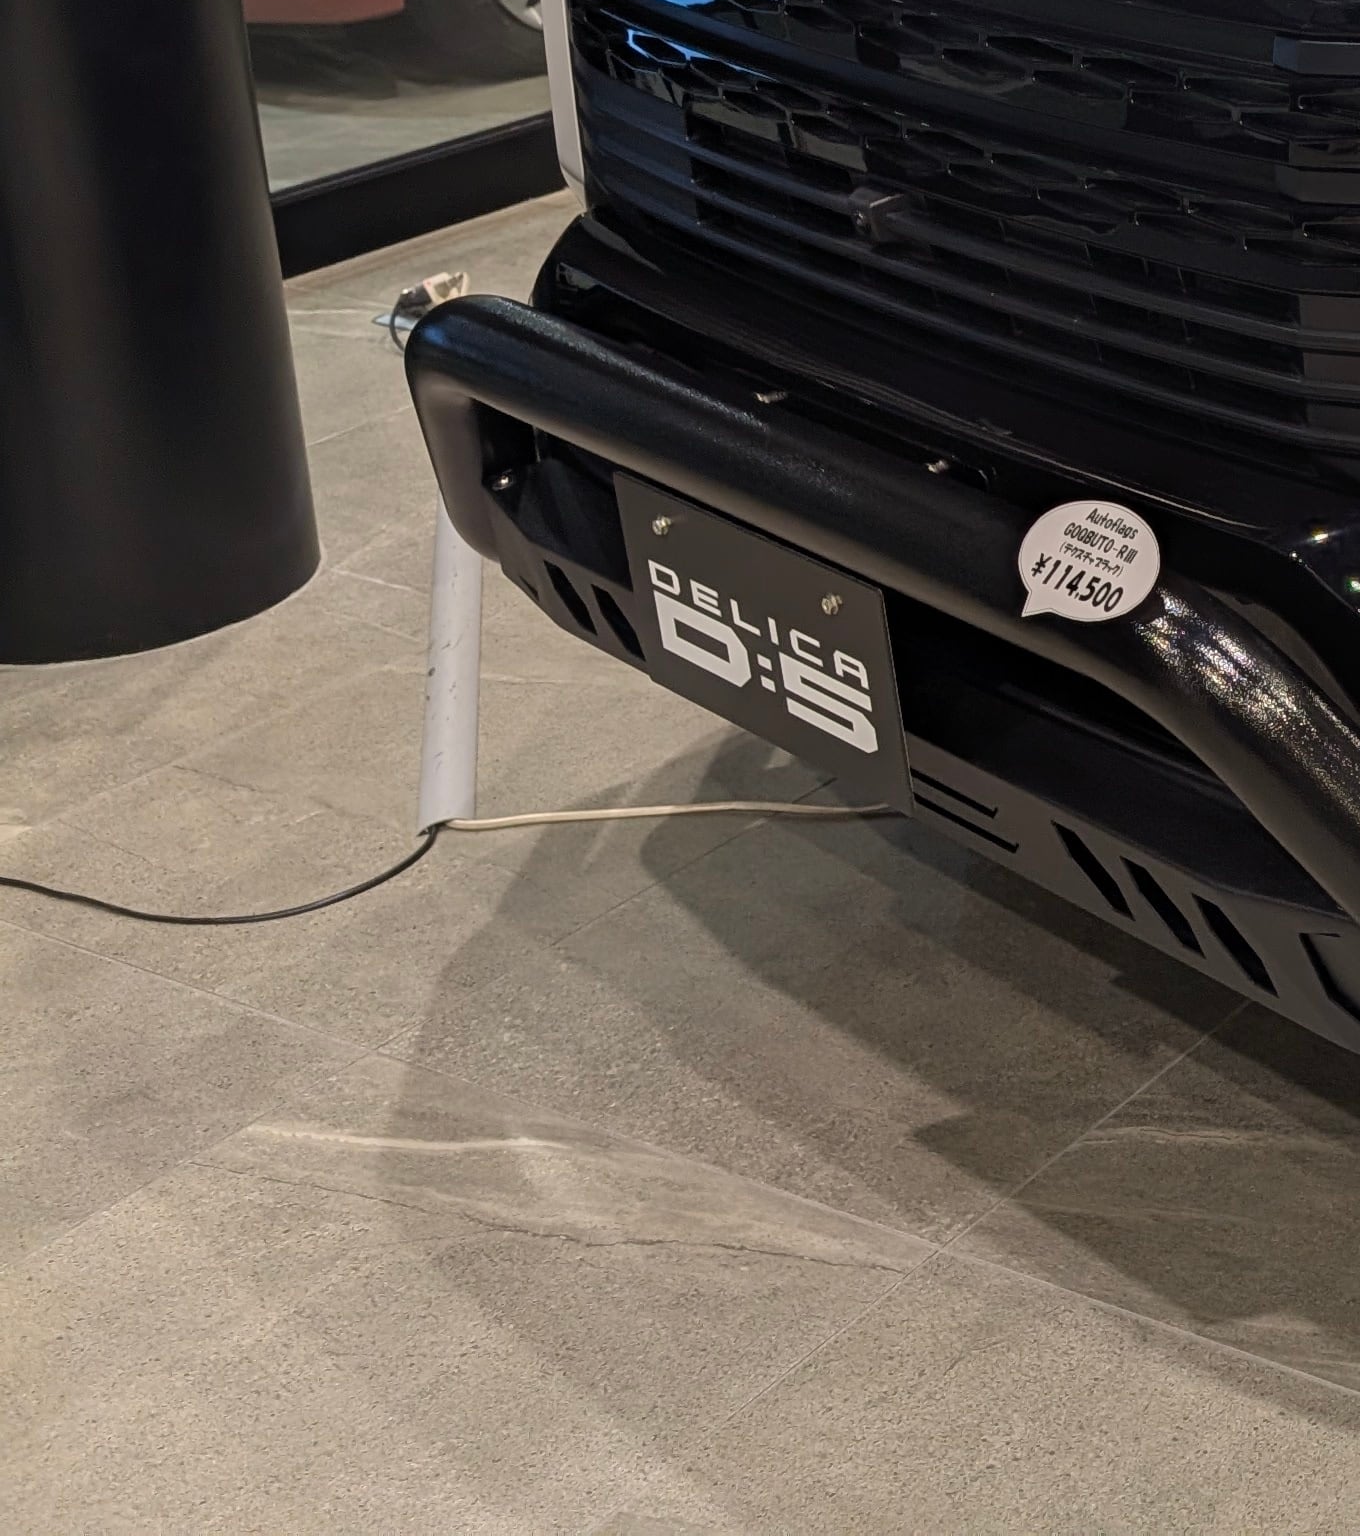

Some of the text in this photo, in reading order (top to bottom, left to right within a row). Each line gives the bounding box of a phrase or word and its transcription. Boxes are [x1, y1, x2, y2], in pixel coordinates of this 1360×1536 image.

[1085, 507, 1139, 540] Autoflags
[648, 559, 873, 690] DELICA
[653, 589, 879, 754] D:5
